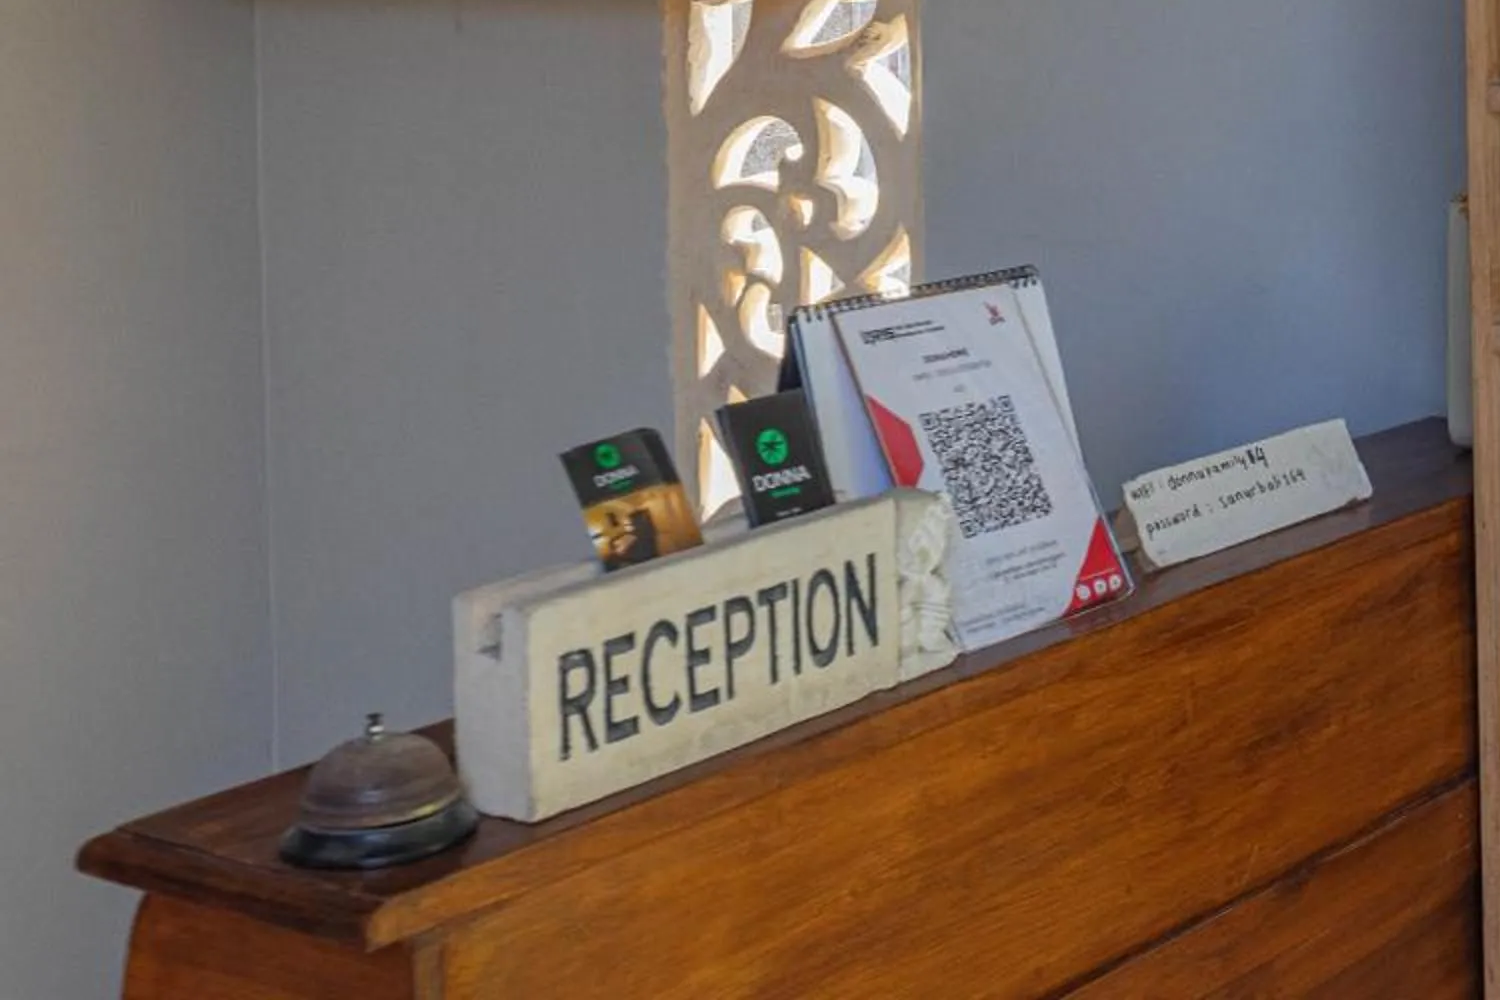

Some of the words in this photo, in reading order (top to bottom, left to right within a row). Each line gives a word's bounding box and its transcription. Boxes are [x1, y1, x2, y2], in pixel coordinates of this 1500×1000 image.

[593, 464, 641, 488] DONNA
[752, 464, 813, 492] DONNA
[1146, 502, 1202, 541] password
[557, 552, 880, 762] RECEPTION
